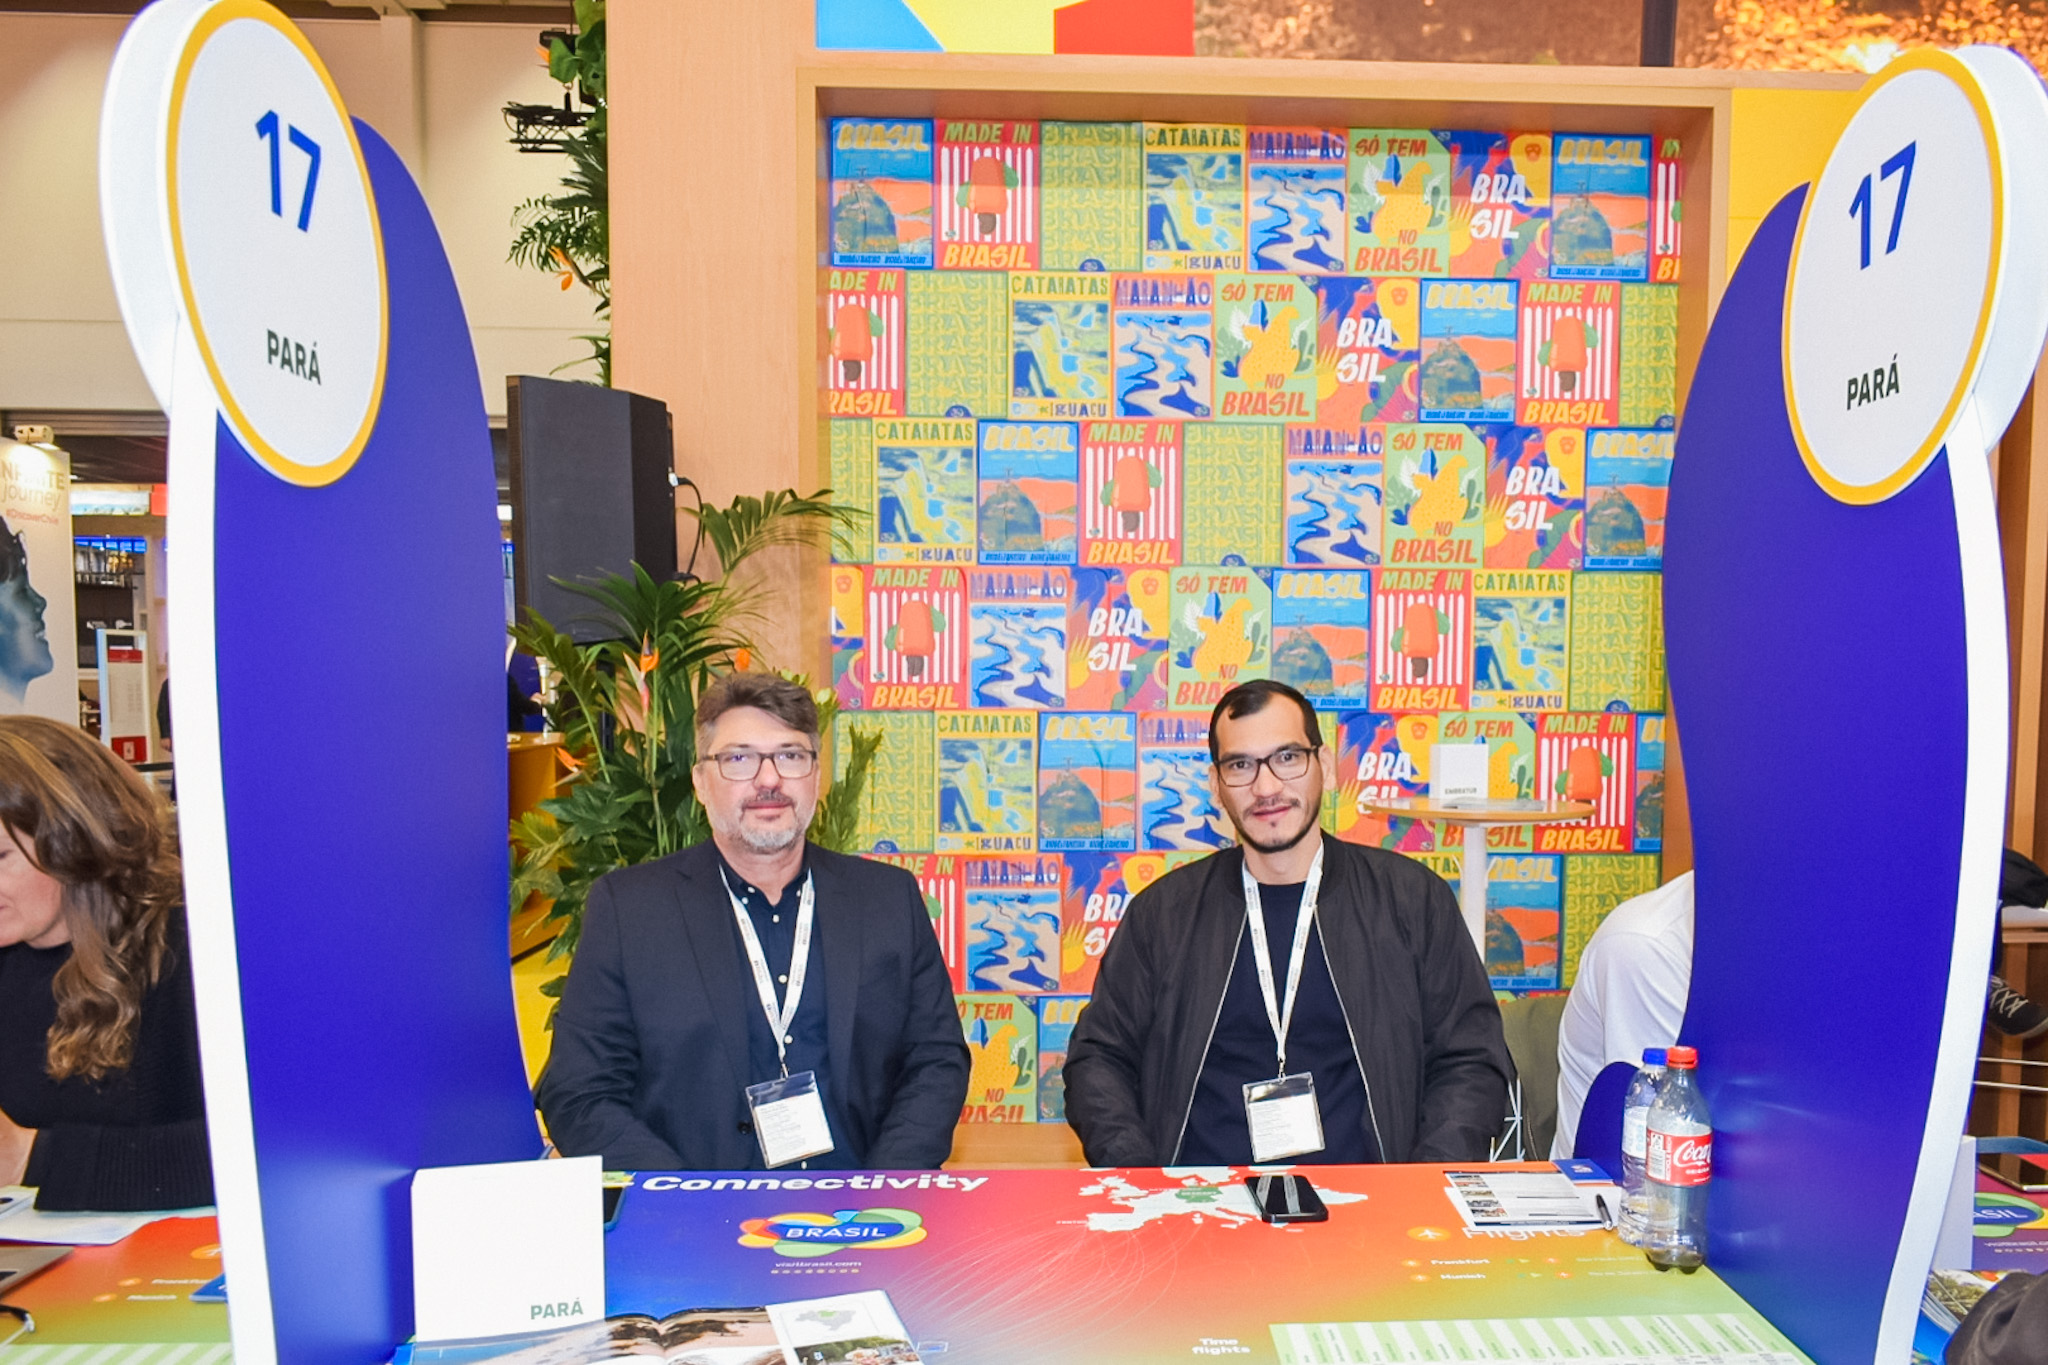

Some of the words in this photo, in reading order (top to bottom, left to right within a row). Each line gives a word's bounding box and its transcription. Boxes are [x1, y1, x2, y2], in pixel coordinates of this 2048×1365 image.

[837, 124, 929, 152] BRASIL
[943, 122, 1003, 143] MADE
[1012, 123, 1032, 144] IN
[1355, 134, 1381, 157] SÓ
[1387, 138, 1427, 157] TEM
[1557, 136, 1647, 166] BRASIL
[255, 109, 321, 233] 17
[1470, 173, 1526, 204] BRA
[1848, 139, 1916, 271] 17
[1470, 210, 1519, 239] SIL
[1399, 229, 1417, 245] NO
[943, 244, 1032, 269] BRASIL
[1354, 246, 1442, 272] BRASIL
[877, 273, 896, 292] IN
[1221, 279, 1246, 302] SÓ
[1254, 283, 1294, 302] TEM
[1526, 283, 1585, 304] MADE
[1593, 284, 1613, 304] IN
[1425, 282, 1514, 310] BRASIL
[1336, 318, 1393, 348] BRA
[266, 328, 322, 386] PARÁ
[1336, 353, 1386, 383] SIL
[1265, 373, 1284, 389] NO
[1847, 353, 1900, 411] PARÁ
[1220, 391, 1310, 417] BRASIL
[1523, 399, 1610, 426] BRASIL
[983, 423, 1076, 452] BRASIL
[1088, 423, 1146, 443] MADE
[1154, 424, 1174, 444] IN
[1393, 430, 1417, 451] SÓ
[1422, 432, 1463, 451] TEM
[1504, 465, 1560, 496] BRA
[1504, 501, 1553, 531] SIL
[1434, 520, 1453, 536] NO
[1086, 541, 1175, 564] BRASIL
[1391, 539, 1478, 564] BRASIL
[872, 568, 931, 587] MADE
[939, 569, 959, 588] IN
[1176, 573, 1201, 594] SÓ
[1207, 576, 1247, 594] TEM
[1276, 573, 1367, 599] BRASIL
[1381, 571, 1437, 591] MADE
[1445, 571, 1465, 591] IN
[1088, 607, 1144, 637] BRA
[1088, 642, 1138, 671] SIL
[1218, 663, 1237, 679] NO
[872, 686, 959, 709] BRASIL
[1376, 687, 1463, 710] BRASIL
[1045, 715, 1133, 742] BRASIL
[1444, 716, 1469, 738] SÓ
[1475, 720, 1515, 738] TEM
[1543, 714, 1600, 734] MADE
[1608, 715, 1628, 733] IN
[1356, 752, 1412, 781] BRA
[1540, 829, 1625, 851] BRASIL
[934, 856, 955, 875] IN
[974, 1002, 1014, 1020] TEM
[984, 1087, 1005, 1103] NO
[642, 1172, 989, 1193] Connectivity
[785, 1227, 886, 1239] BRASIL
[530, 1297, 584, 1321] PARÁ
[1192, 1346, 1251, 1356] flights
[1199, 1337, 1239, 1347] Time
